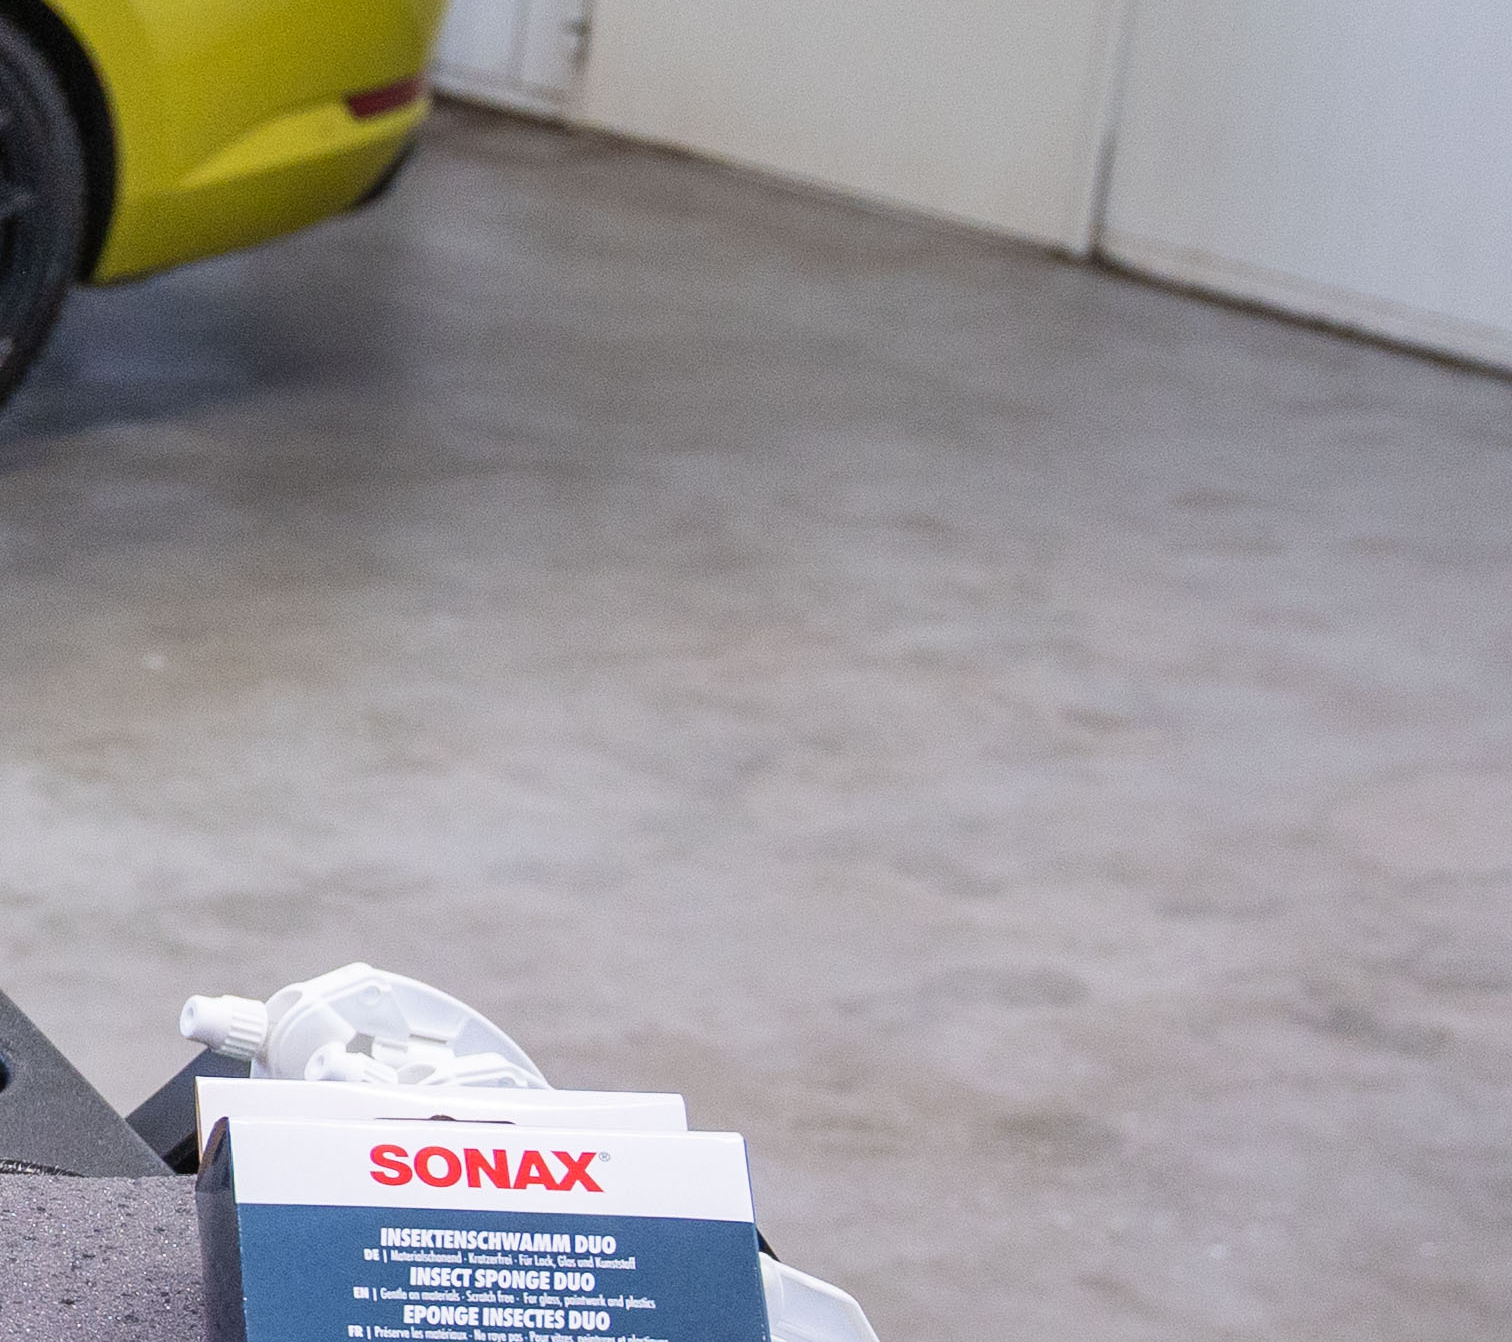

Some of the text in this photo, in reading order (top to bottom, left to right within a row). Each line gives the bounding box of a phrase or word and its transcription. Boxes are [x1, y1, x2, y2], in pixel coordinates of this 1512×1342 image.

[369, 1144, 605, 1193] SONAX
[381, 1228, 616, 1255] INSEKTENSCHWAMM DUO
[410, 1267, 595, 1291] INSECT SPONGE DUO
[403, 1305, 611, 1331] EPONGE INSECTES DUO
